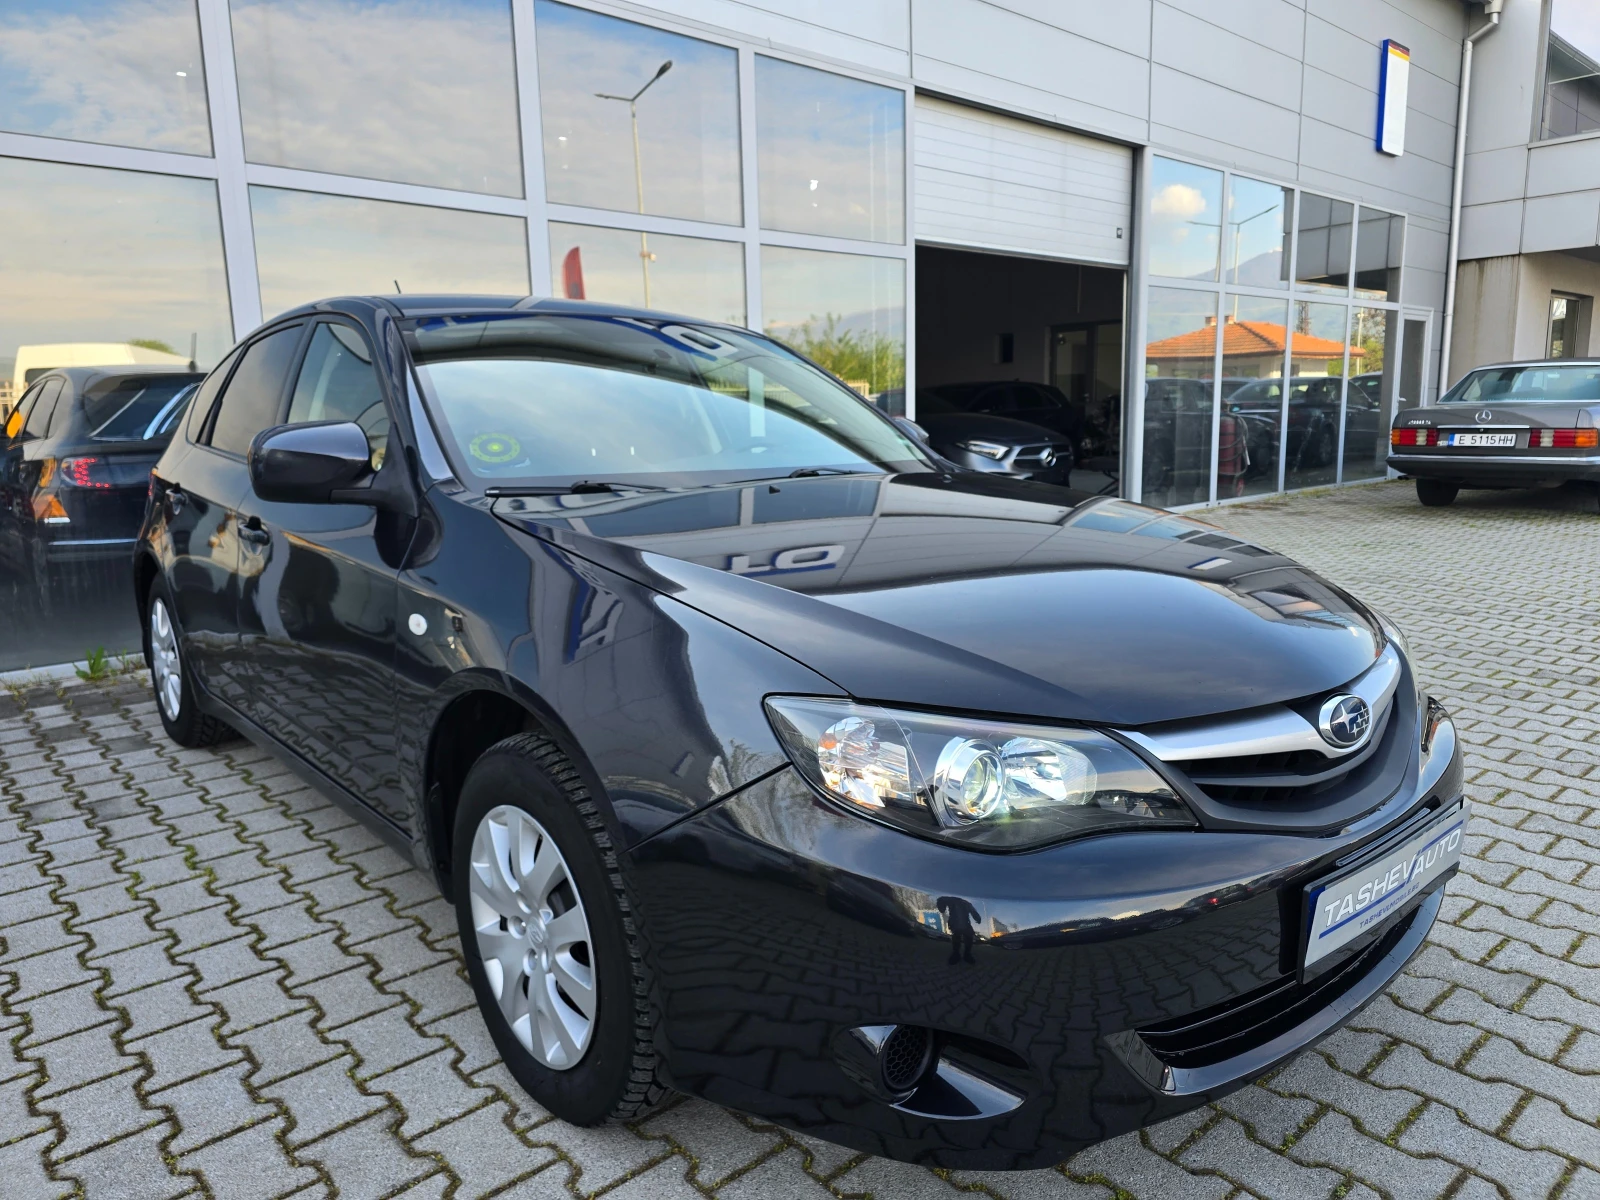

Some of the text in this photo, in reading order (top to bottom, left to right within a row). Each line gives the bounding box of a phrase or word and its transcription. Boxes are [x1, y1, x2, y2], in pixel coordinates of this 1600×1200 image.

[1458, 435, 1514, 445] E 5115 HH
[1324, 828, 1462, 927] TASHEVAUTO
